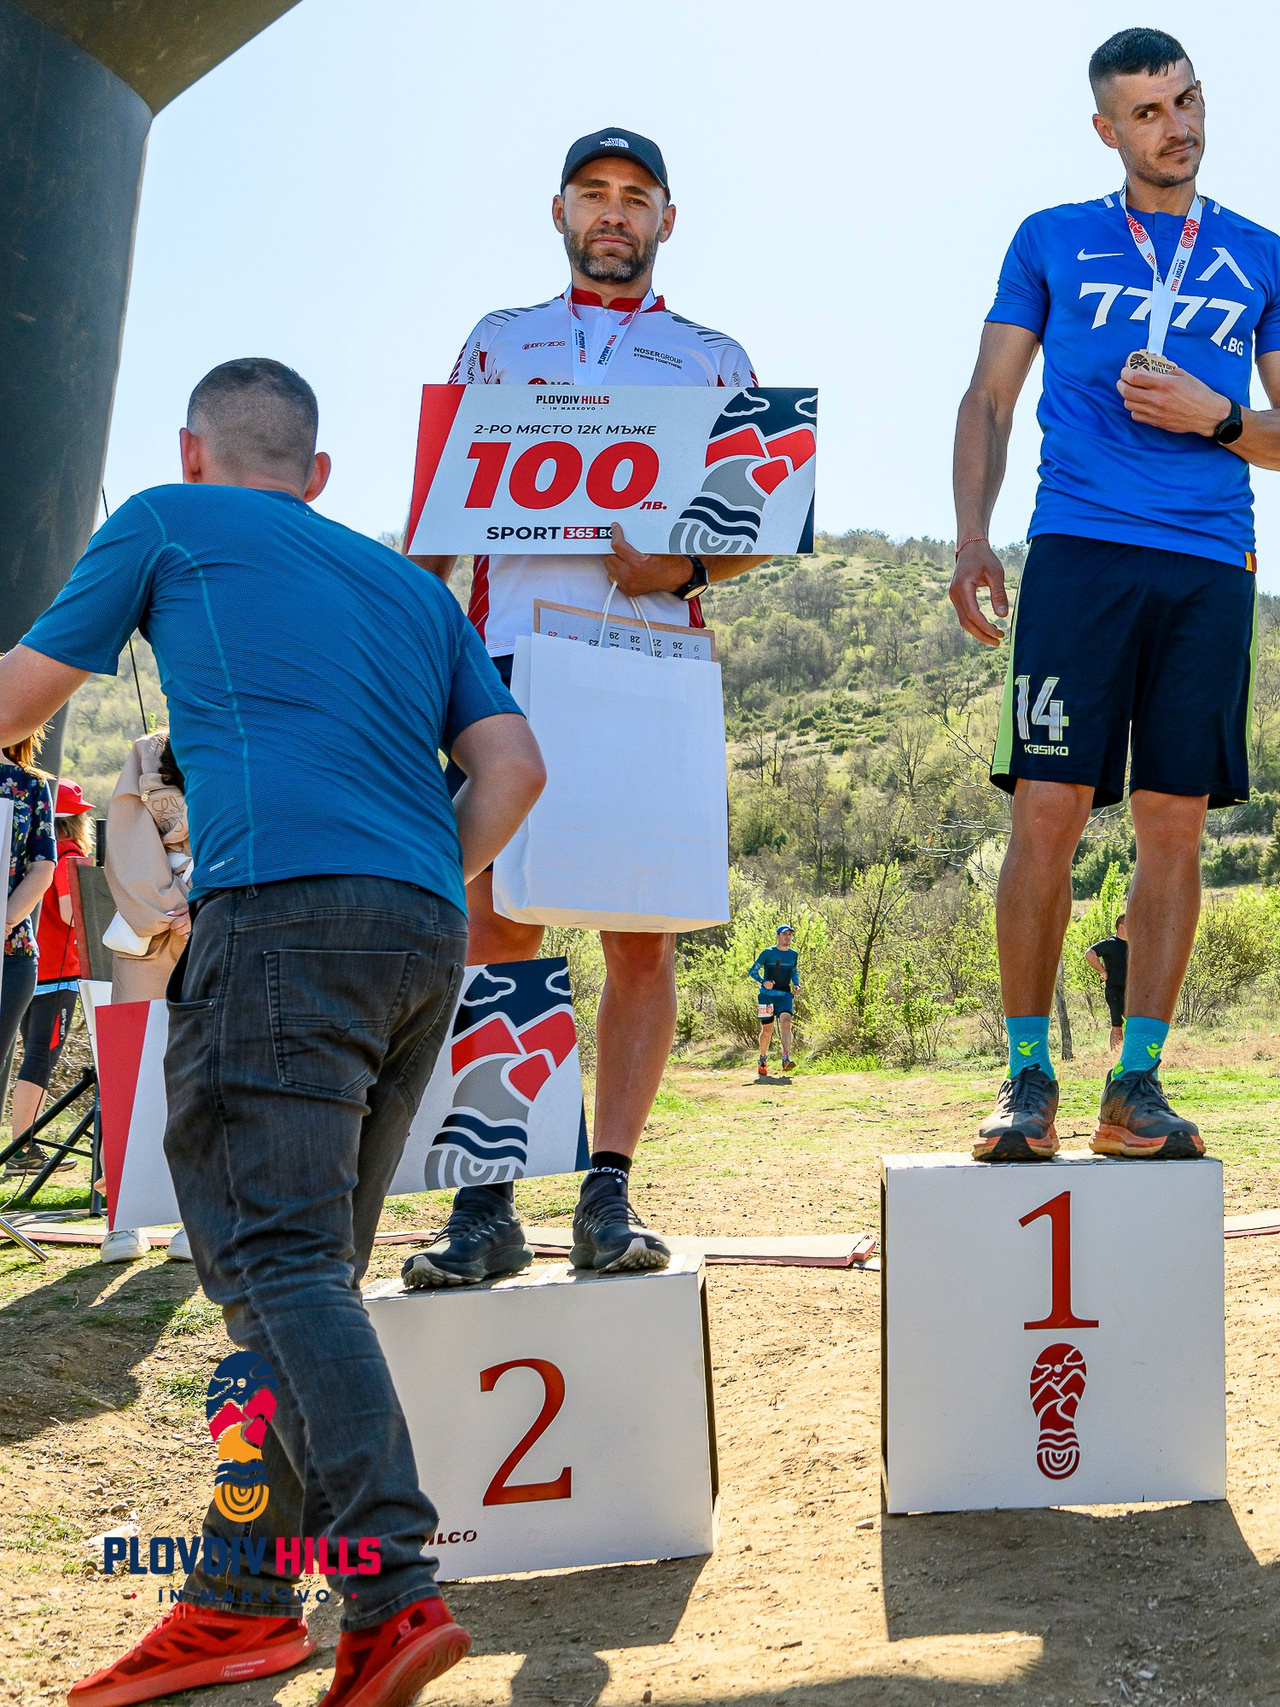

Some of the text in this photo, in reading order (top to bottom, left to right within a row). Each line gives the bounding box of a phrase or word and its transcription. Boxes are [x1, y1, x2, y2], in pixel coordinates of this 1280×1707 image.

[473, 424, 513, 435] 2-РО
[516, 424, 574, 435] МЯСТО
[605, 424, 657, 436] МЪЖЕ
[536, 395, 610, 405] PLOVDIV HILLS
[463, 440, 660, 510] 100
[486, 525, 561, 541] SPORT
[1014, 674, 1069, 742] 14
[1017, 1190, 1100, 1331] 1
[479, 1358, 573, 1507] 2
